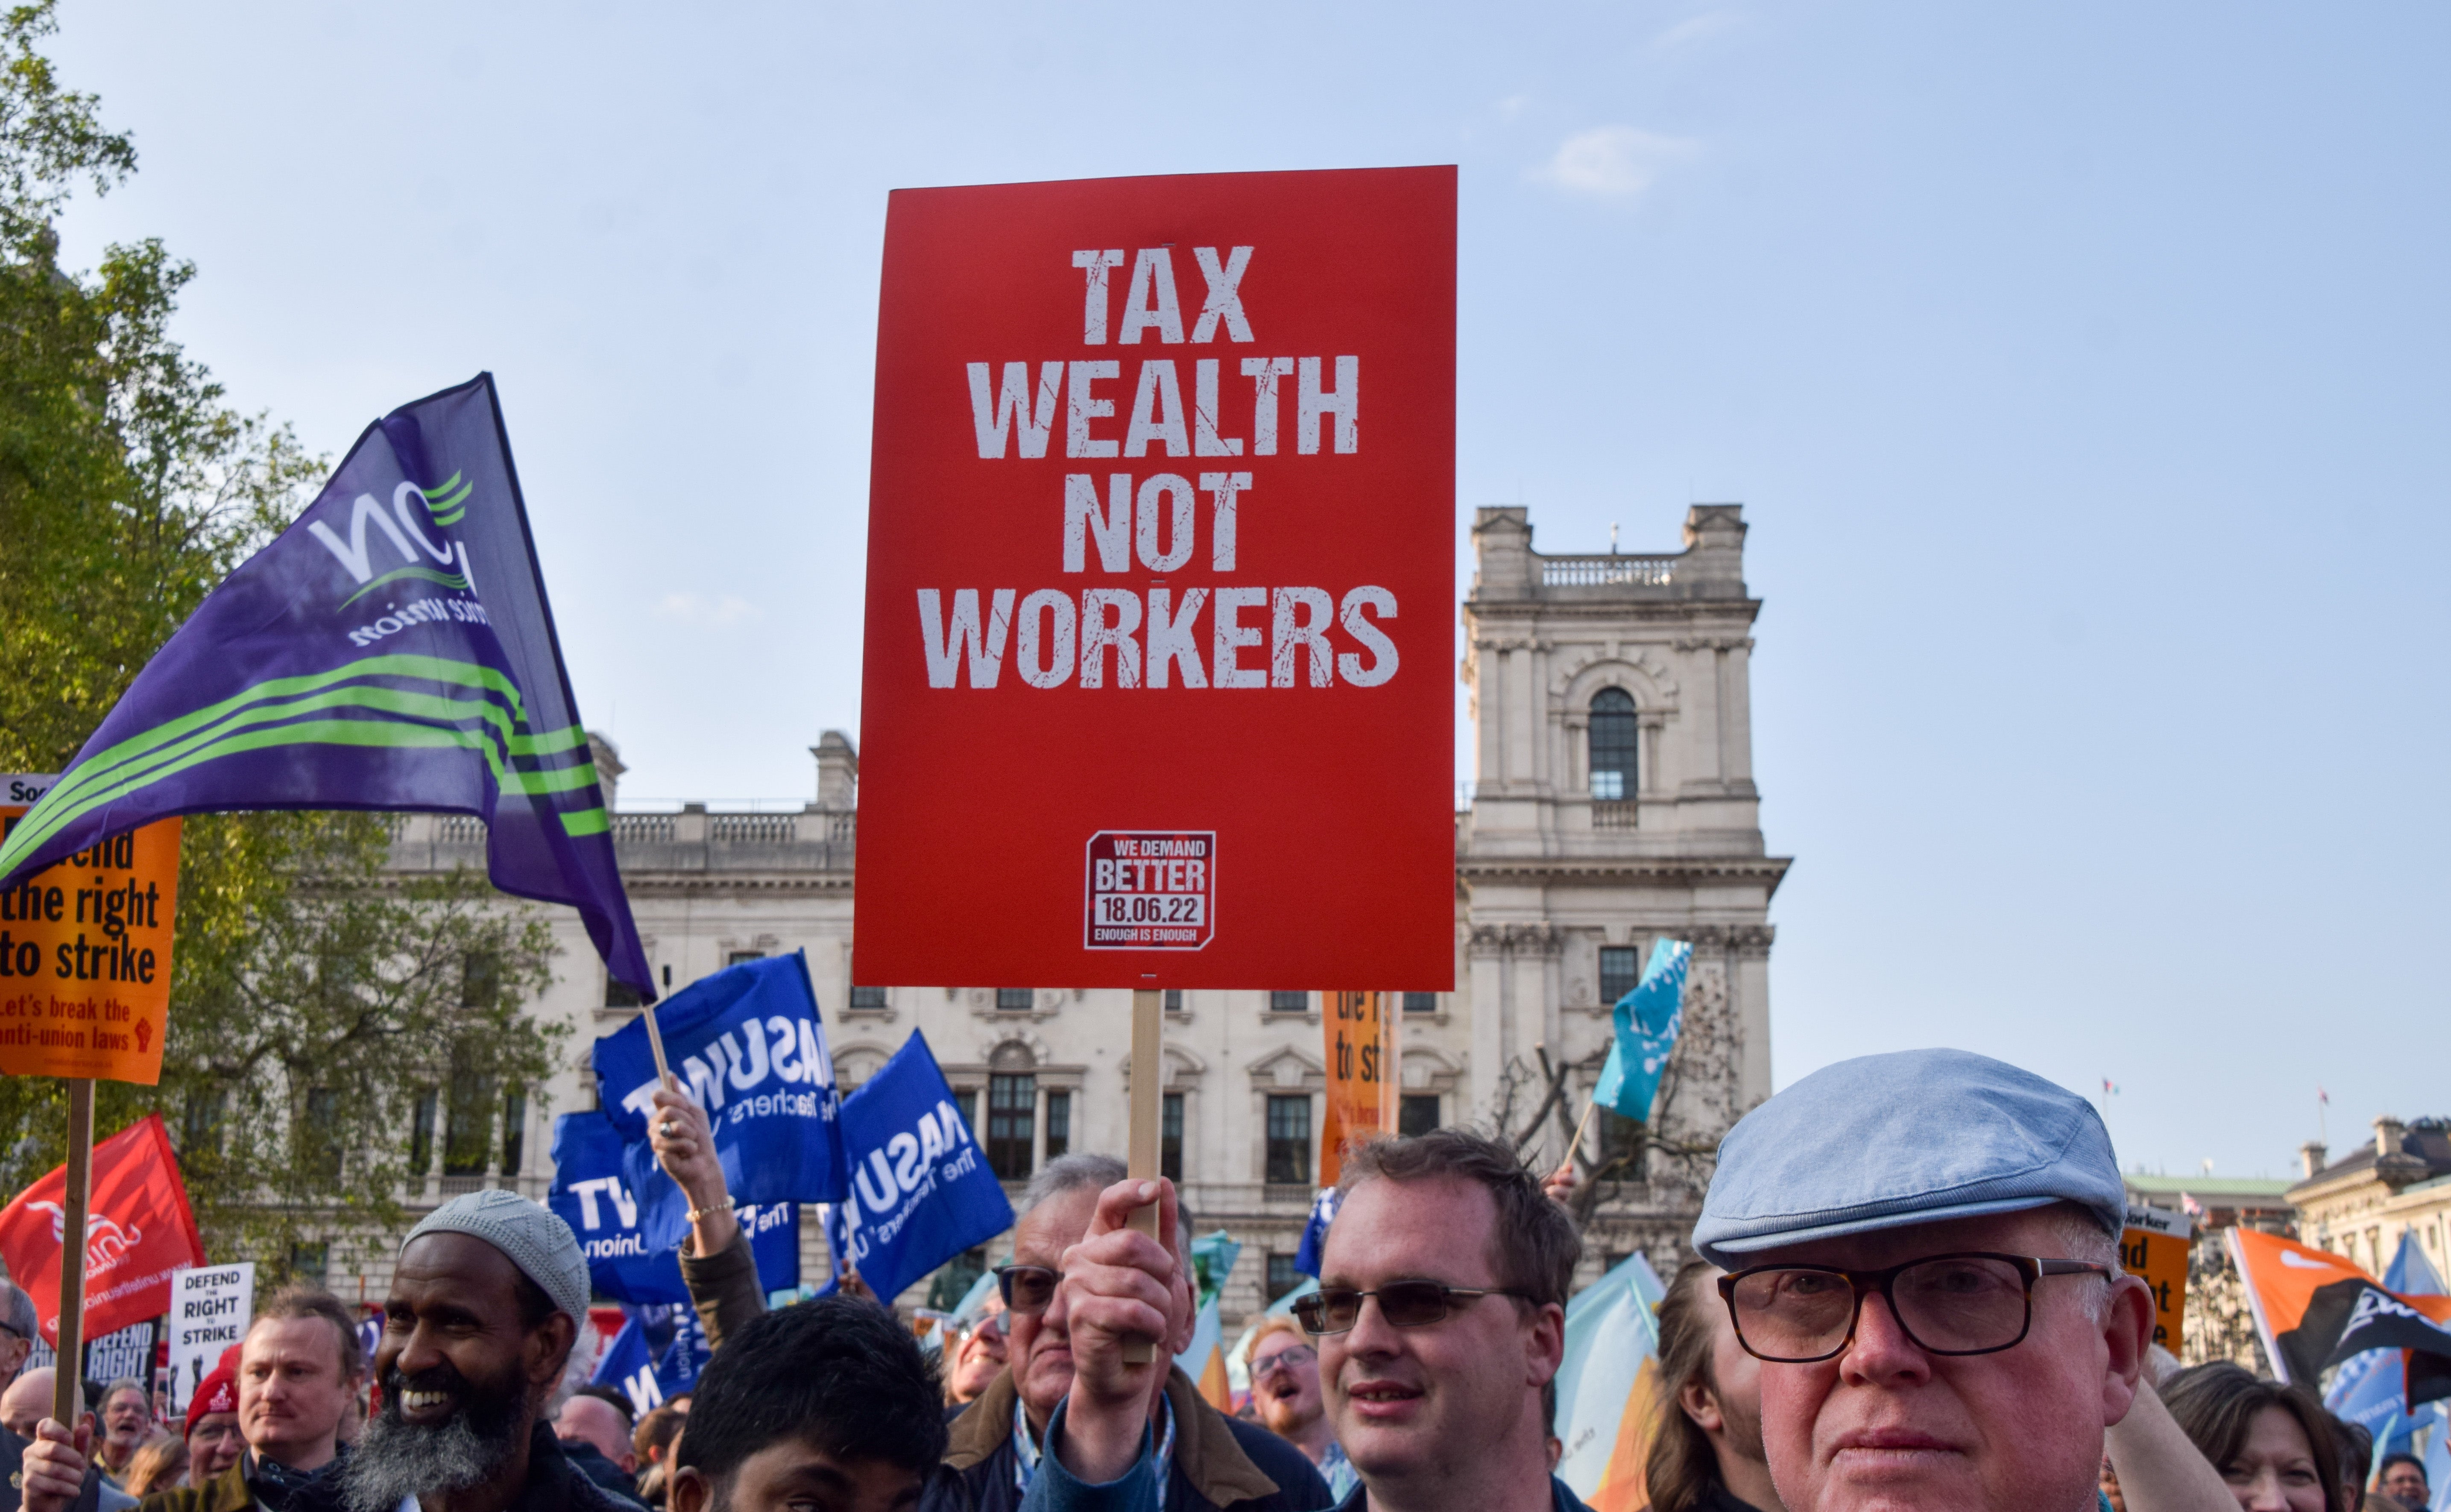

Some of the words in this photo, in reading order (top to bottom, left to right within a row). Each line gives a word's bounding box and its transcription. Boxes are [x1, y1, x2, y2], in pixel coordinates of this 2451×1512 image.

[1072, 246, 1254, 345] TAX
[966, 355, 1359, 459] WEALTH
[1063, 472, 1253, 573] NOT
[917, 585, 1399, 689] WORKERS
[59, 831, 133, 869] end
[1113, 840, 1138, 857] WE
[1141, 840, 1206, 857] DEMAND
[1095, 859, 1205, 891] BETTER
[0, 880, 63, 921] the
[77, 877, 159, 936] right
[1103, 897, 1198, 922] 18.06.22
[1095, 929, 1137, 940] ENOUGH
[1140, 929, 1151, 941] IS
[1153, 929, 1197, 941] ENOUGH
[0, 931, 40, 977] to
[56, 933, 155, 984] strike
[50, 994, 97, 1021] break
[105, 997, 130, 1022] the
[93, 1026, 128, 1051] laws
[185, 1271, 240, 1290] DEFEND
[185, 1296, 239, 1318] RIGHT
[183, 1325, 237, 1345] STRIKE
[88, 1346, 151, 1381] RIGHT
